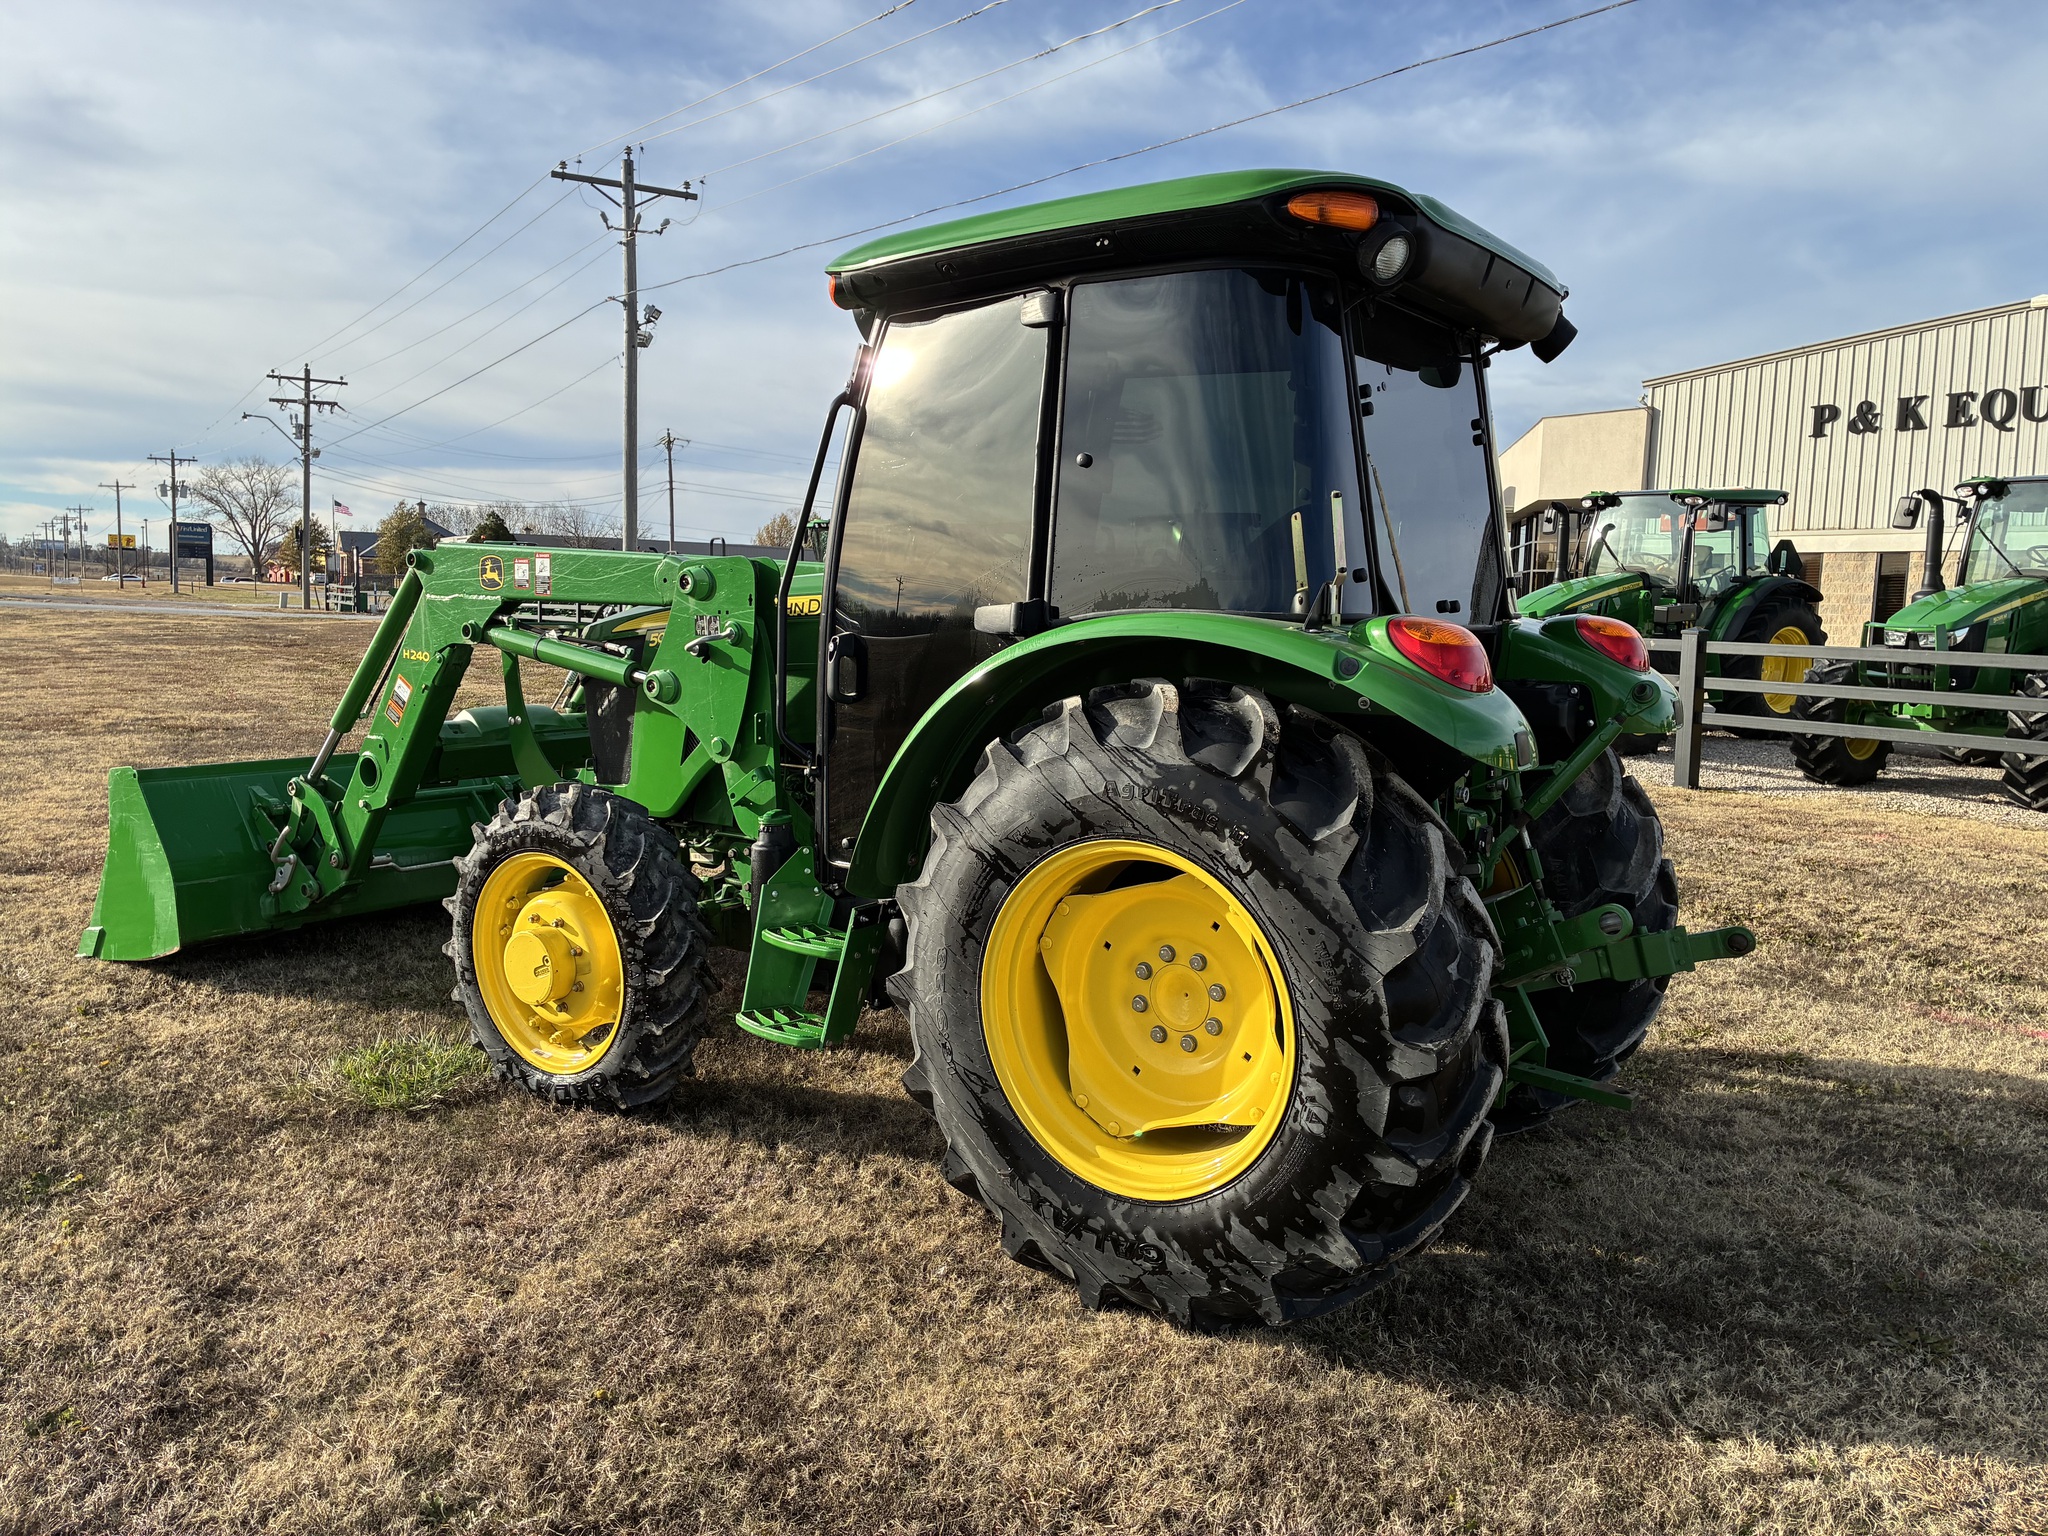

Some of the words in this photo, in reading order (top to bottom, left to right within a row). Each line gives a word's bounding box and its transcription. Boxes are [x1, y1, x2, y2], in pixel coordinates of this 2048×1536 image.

[1808, 404, 1840, 438] P
[1849, 400, 1881, 435] &
[1895, 395, 1929, 432] K
[402, 648, 430, 663] H240
[1315, 941, 1344, 1011] TUBELESS
